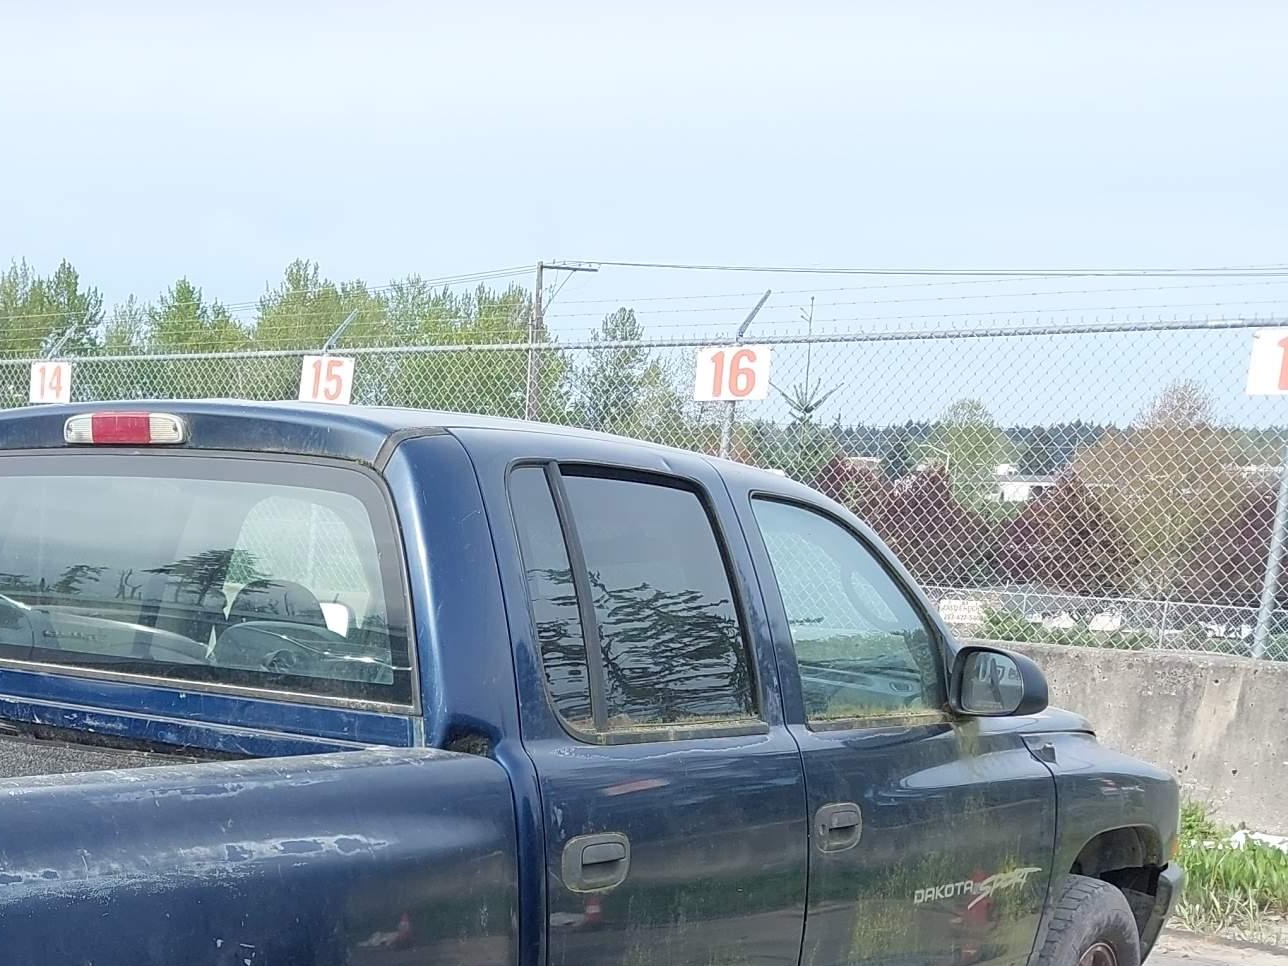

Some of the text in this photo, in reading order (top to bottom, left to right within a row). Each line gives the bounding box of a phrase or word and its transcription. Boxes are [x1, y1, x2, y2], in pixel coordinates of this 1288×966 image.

[39, 366, 62, 399] 14
[313, 360, 344, 400] 15
[711, 349, 756, 397] 16
[914, 880, 973, 904] DAKOTA
